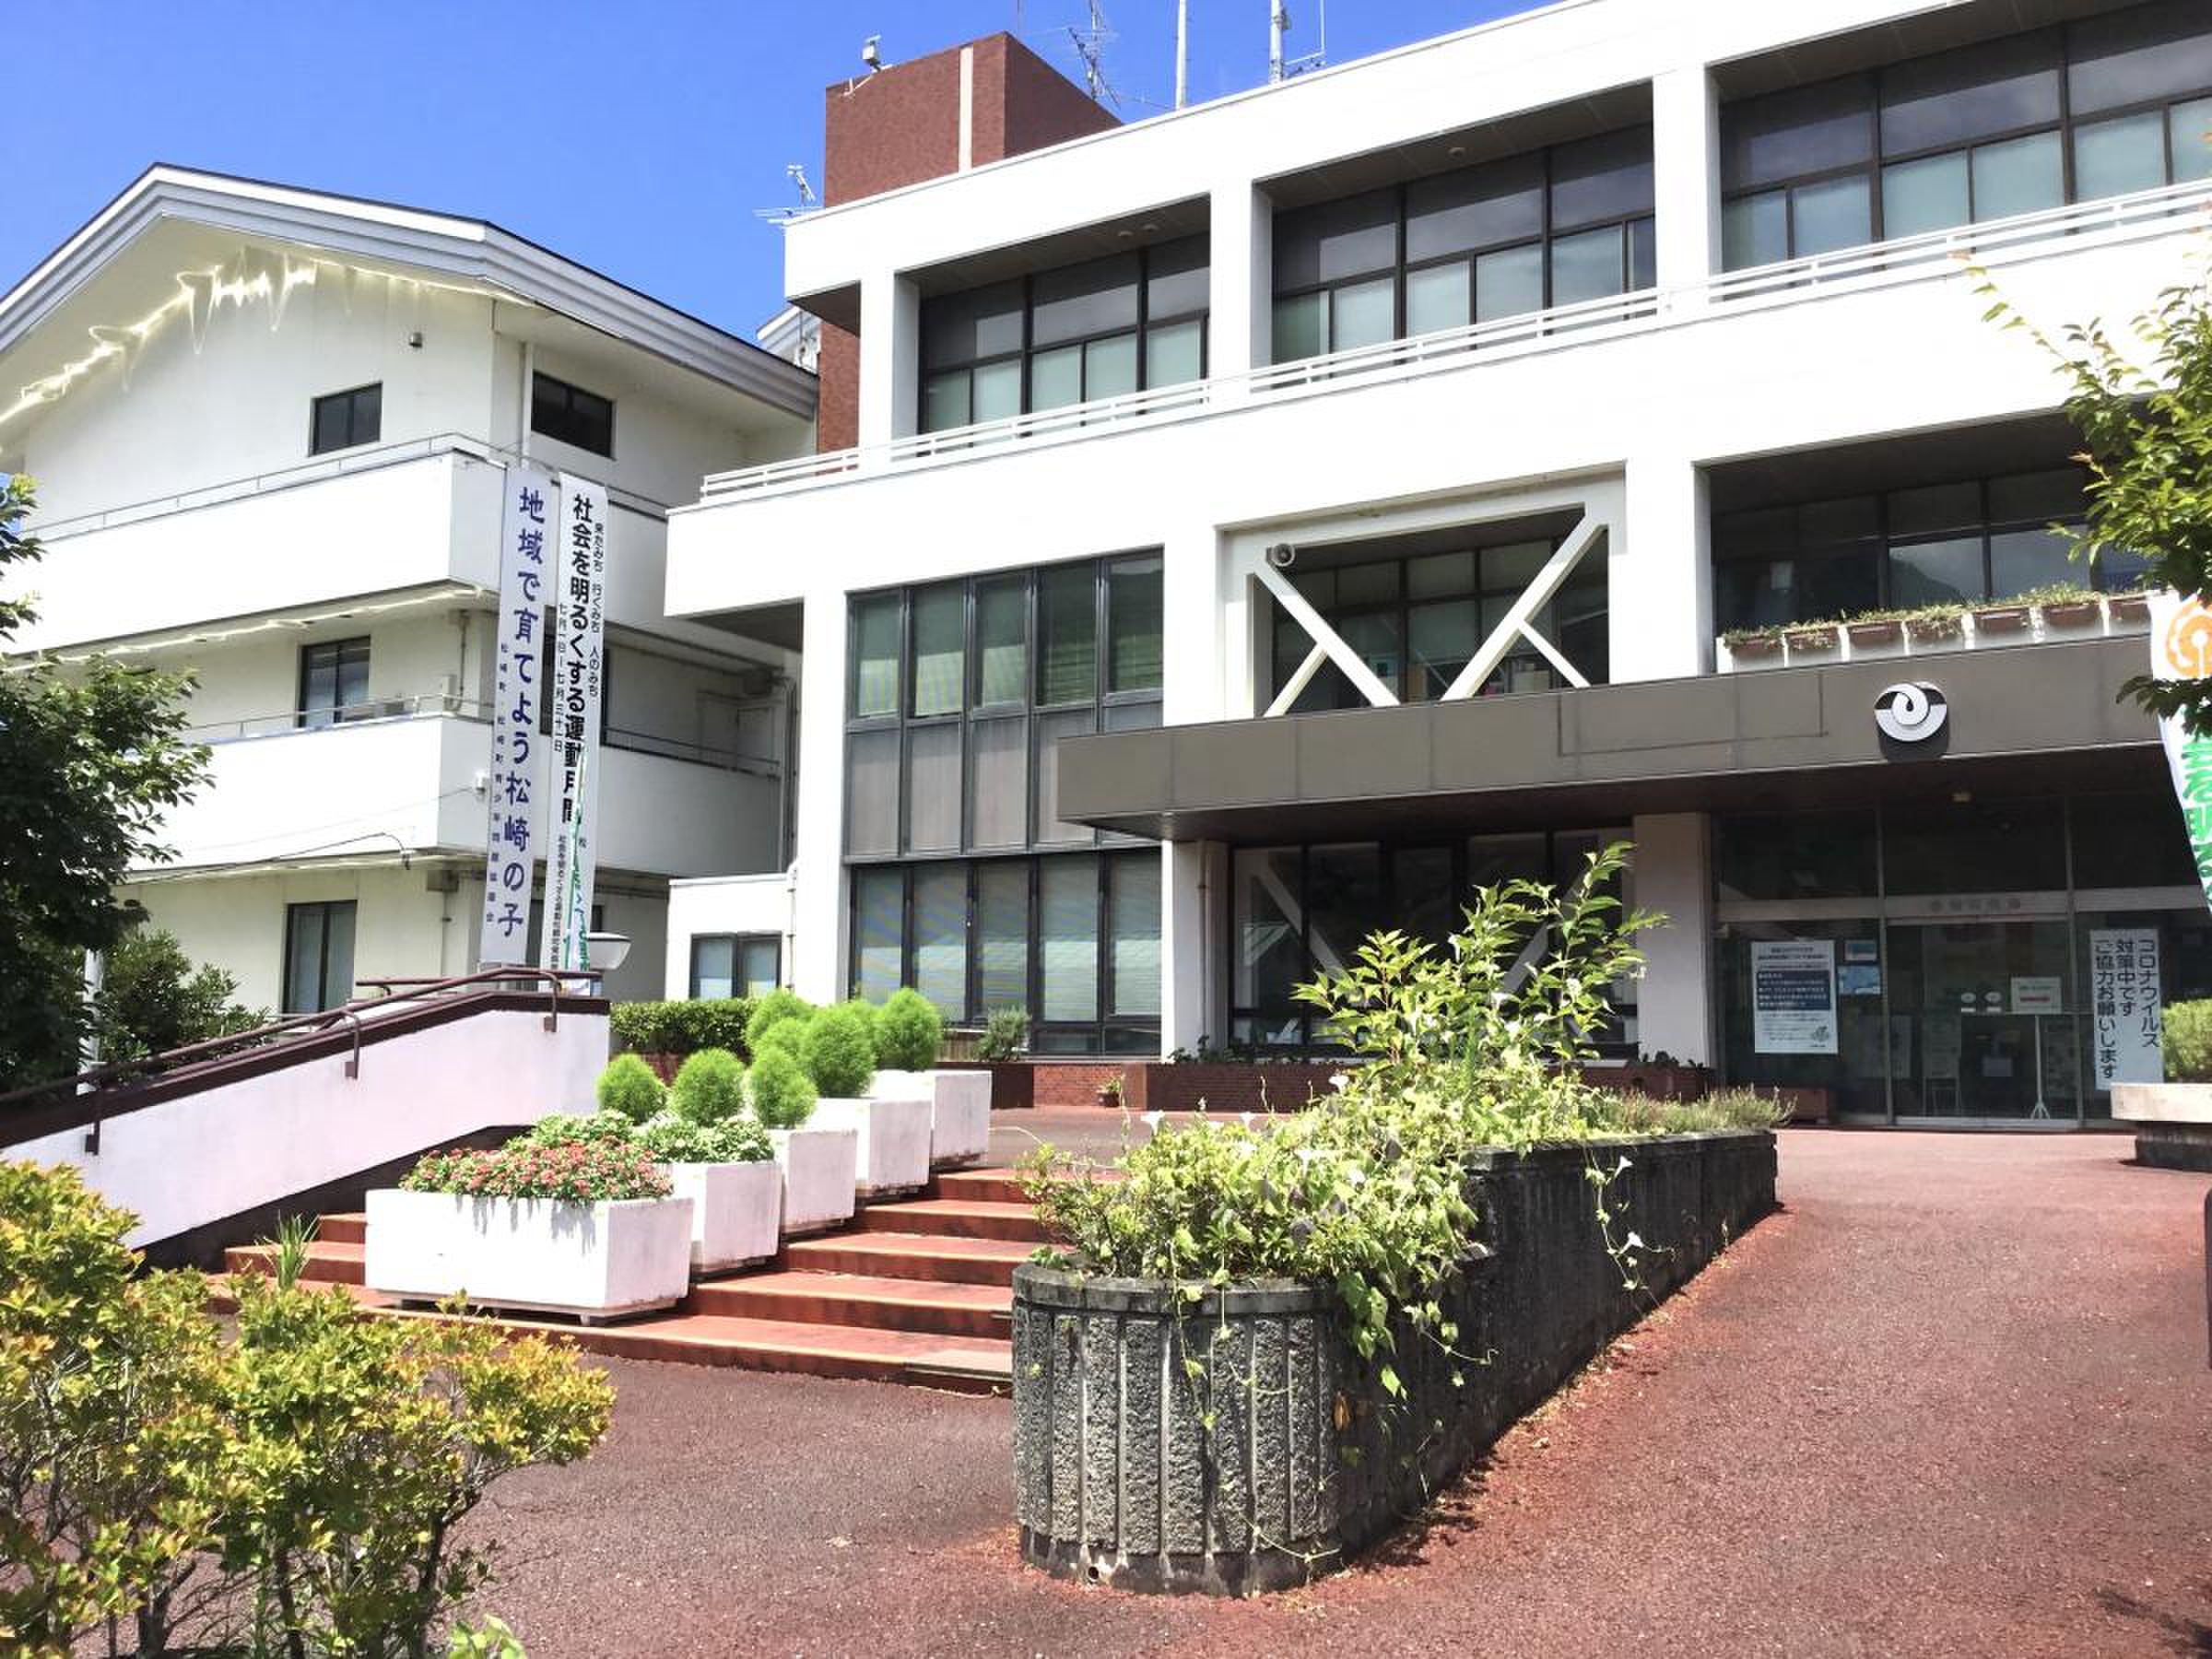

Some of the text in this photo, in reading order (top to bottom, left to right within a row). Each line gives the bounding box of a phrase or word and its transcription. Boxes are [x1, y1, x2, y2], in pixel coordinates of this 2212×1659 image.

[499, 487, 545, 936] 地域で育てよう松崎の子
[2095, 939, 2117, 1078] ご協力お願いします
[2116, 939, 2136, 1017] 対策中です
